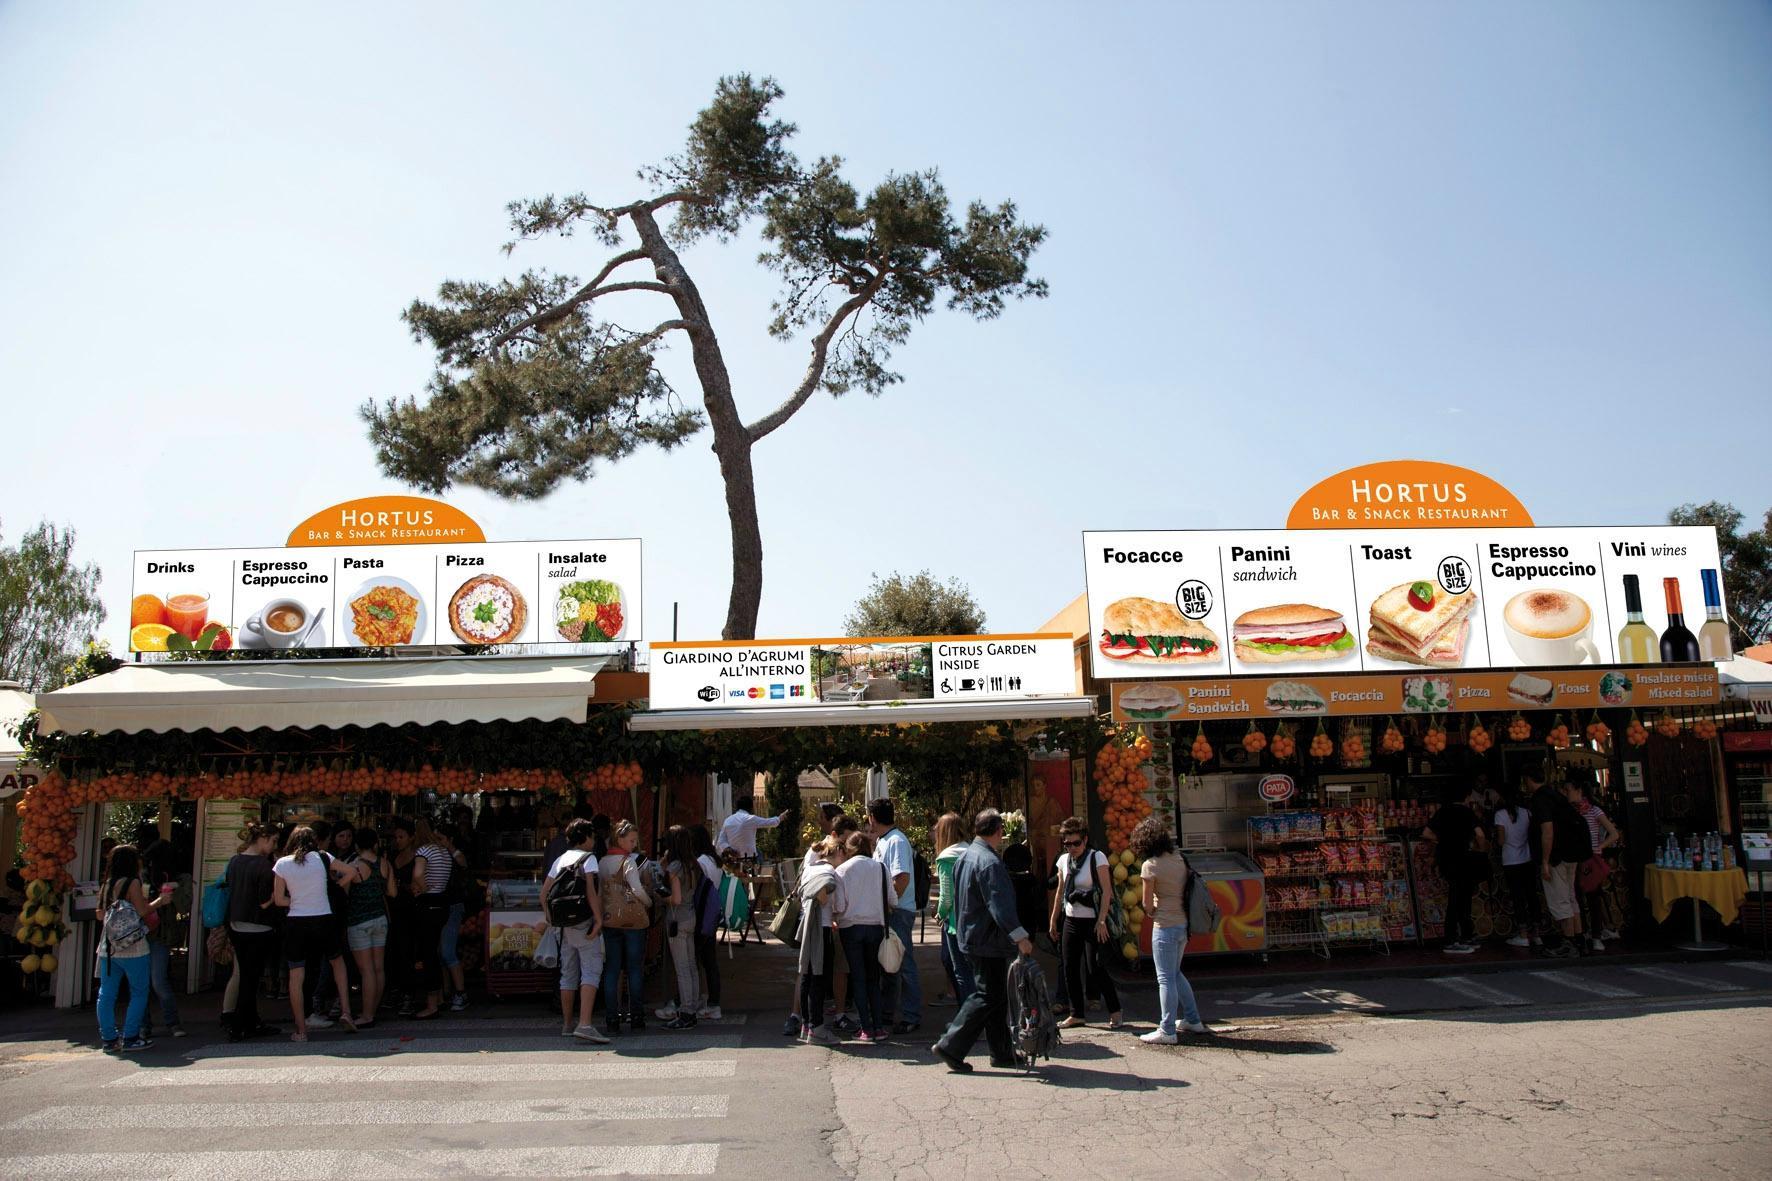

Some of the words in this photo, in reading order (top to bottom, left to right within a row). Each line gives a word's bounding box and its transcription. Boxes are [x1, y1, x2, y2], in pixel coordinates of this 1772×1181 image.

[1351, 478, 1467, 503] HORTUS
[341, 510, 433, 527] HORTUS
[1312, 507, 1339, 520] BAR
[1347, 508, 1357, 520] &
[1364, 507, 1410, 520] SNACK
[1417, 506, 1507, 519] RESTAURANT
[308, 530, 330, 540] BAR
[335, 530, 343, 539] &
[349, 529, 386, 539] SNACK
[391, 528, 465, 538] RESTAURANT
[1103, 547, 1184, 564] Focacce
[1231, 545, 1291, 562] Panini
[1360, 544, 1412, 561] Toast
[1489, 543, 1570, 562] Espresso
[1611, 541, 1647, 557] Vini
[1650, 543, 1688, 557] wines
[343, 557, 384, 569] Pasta
[446, 555, 485, 567] Pizza
[548, 551, 607, 564] Insalate
[147, 561, 195, 574] Drinks
[242, 559, 308, 574] Espresso
[548, 567, 578, 578] salad
[1232, 565, 1298, 582] sandwich
[1443, 562, 1464, 578] BIG
[1491, 562, 1597, 581] Cappuccino
[241, 572, 329, 587] Cappuccino
[1446, 577, 1467, 589] SIZE
[1182, 586, 1205, 602] BIG
[1185, 601, 1207, 613] SIZE
[663, 651, 733, 665] GIARDINO
[738, 649, 805, 663] D'AGRUMI
[938, 644, 983, 657] CITRUS
[987, 643, 1037, 656] GARDEN
[719, 663, 805, 678] ALL'INTERNO
[939, 659, 980, 671] INSIDE
[1636, 672, 1681, 685] Insalate
[1683, 673, 1714, 683] miste
[1188, 685, 1231, 698] Panini
[1330, 689, 1384, 702] Focaccia
[1458, 686, 1491, 698] Pizza
[1558, 683, 1590, 694] Toast
[1648, 687, 1683, 699] Mixed
[1684, 686, 1713, 698] salad
[1187, 699, 1250, 714] Sandwich
[1266, 783, 1287, 793] PATA
